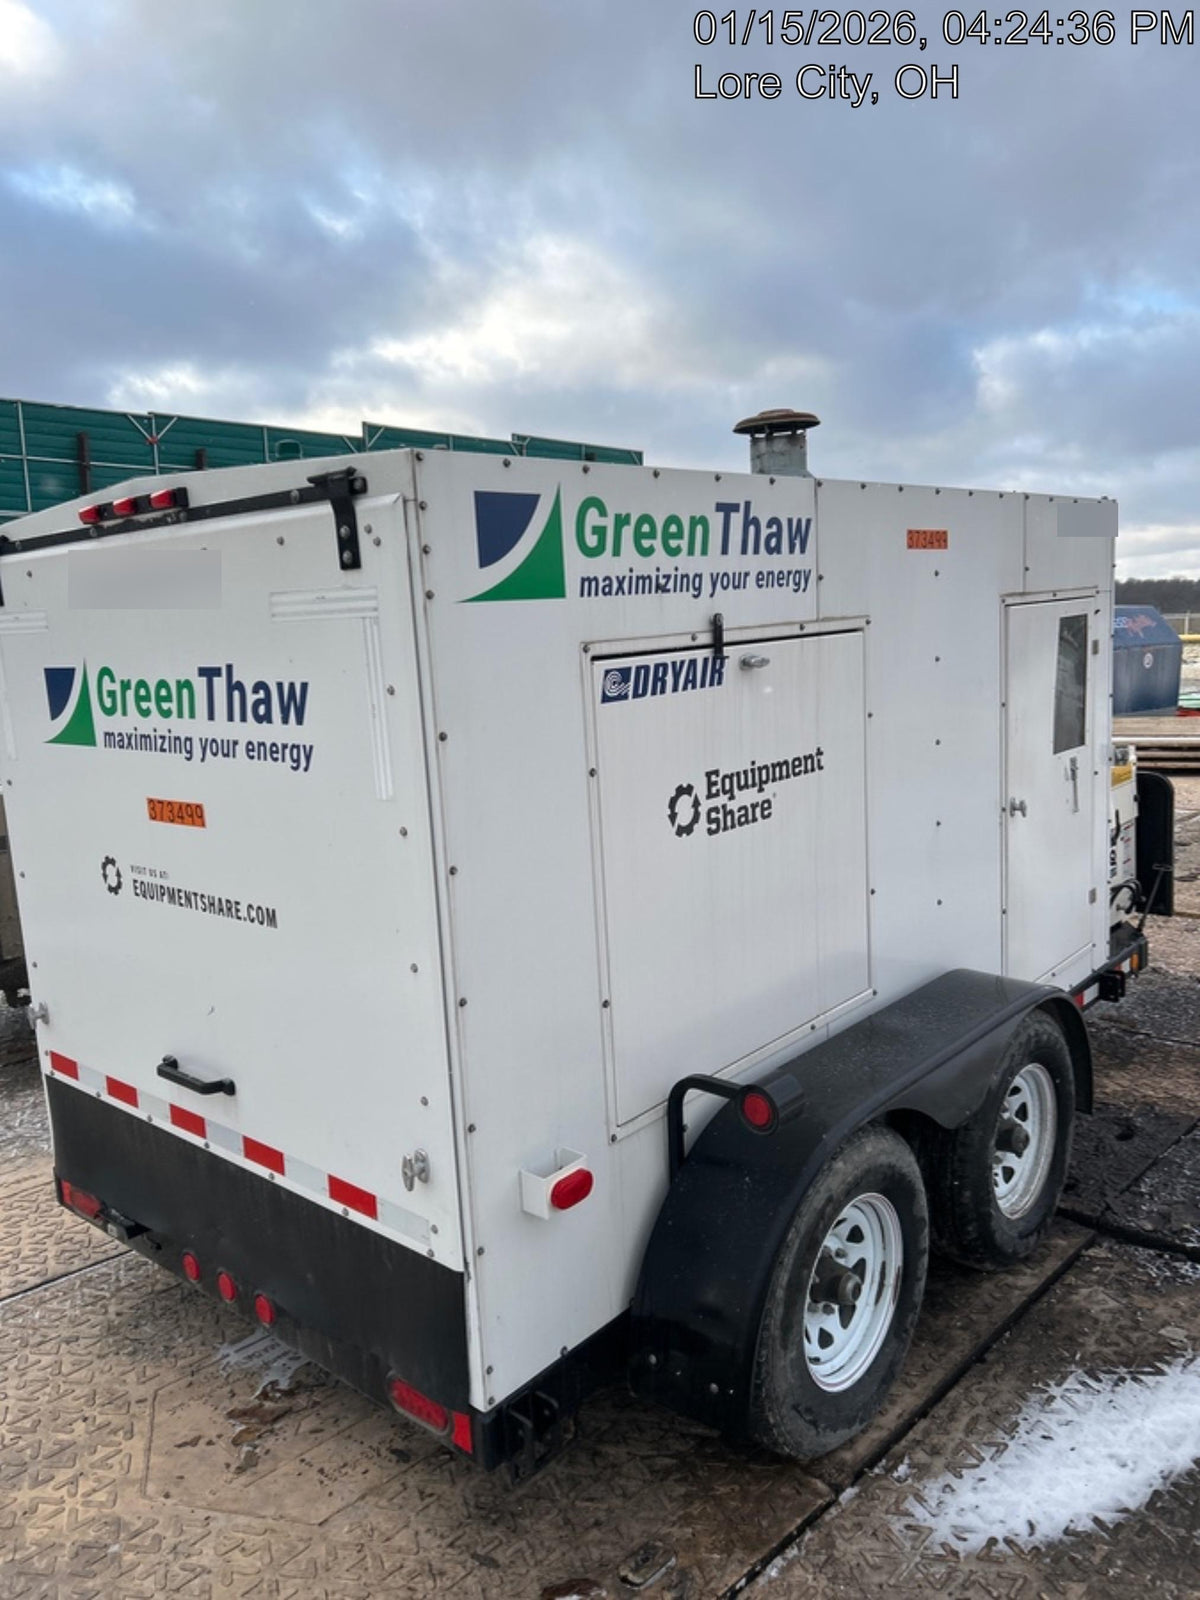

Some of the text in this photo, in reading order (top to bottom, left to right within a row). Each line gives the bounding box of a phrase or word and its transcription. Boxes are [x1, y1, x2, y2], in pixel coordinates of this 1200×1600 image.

[575, 496, 812, 558] GreenThaw
[580, 566, 811, 599] maximizing your energy
[97, 663, 309, 726] GreenThaw
[632, 655, 727, 700] DRYAIR
[104, 727, 314, 772] maximizing your energy
[705, 747, 824, 801] Equipment
[147, 798, 205, 827] 373499
[706, 797, 773, 836] Share
[132, 879, 278, 929] EQUIPMENTSHARE.COM
